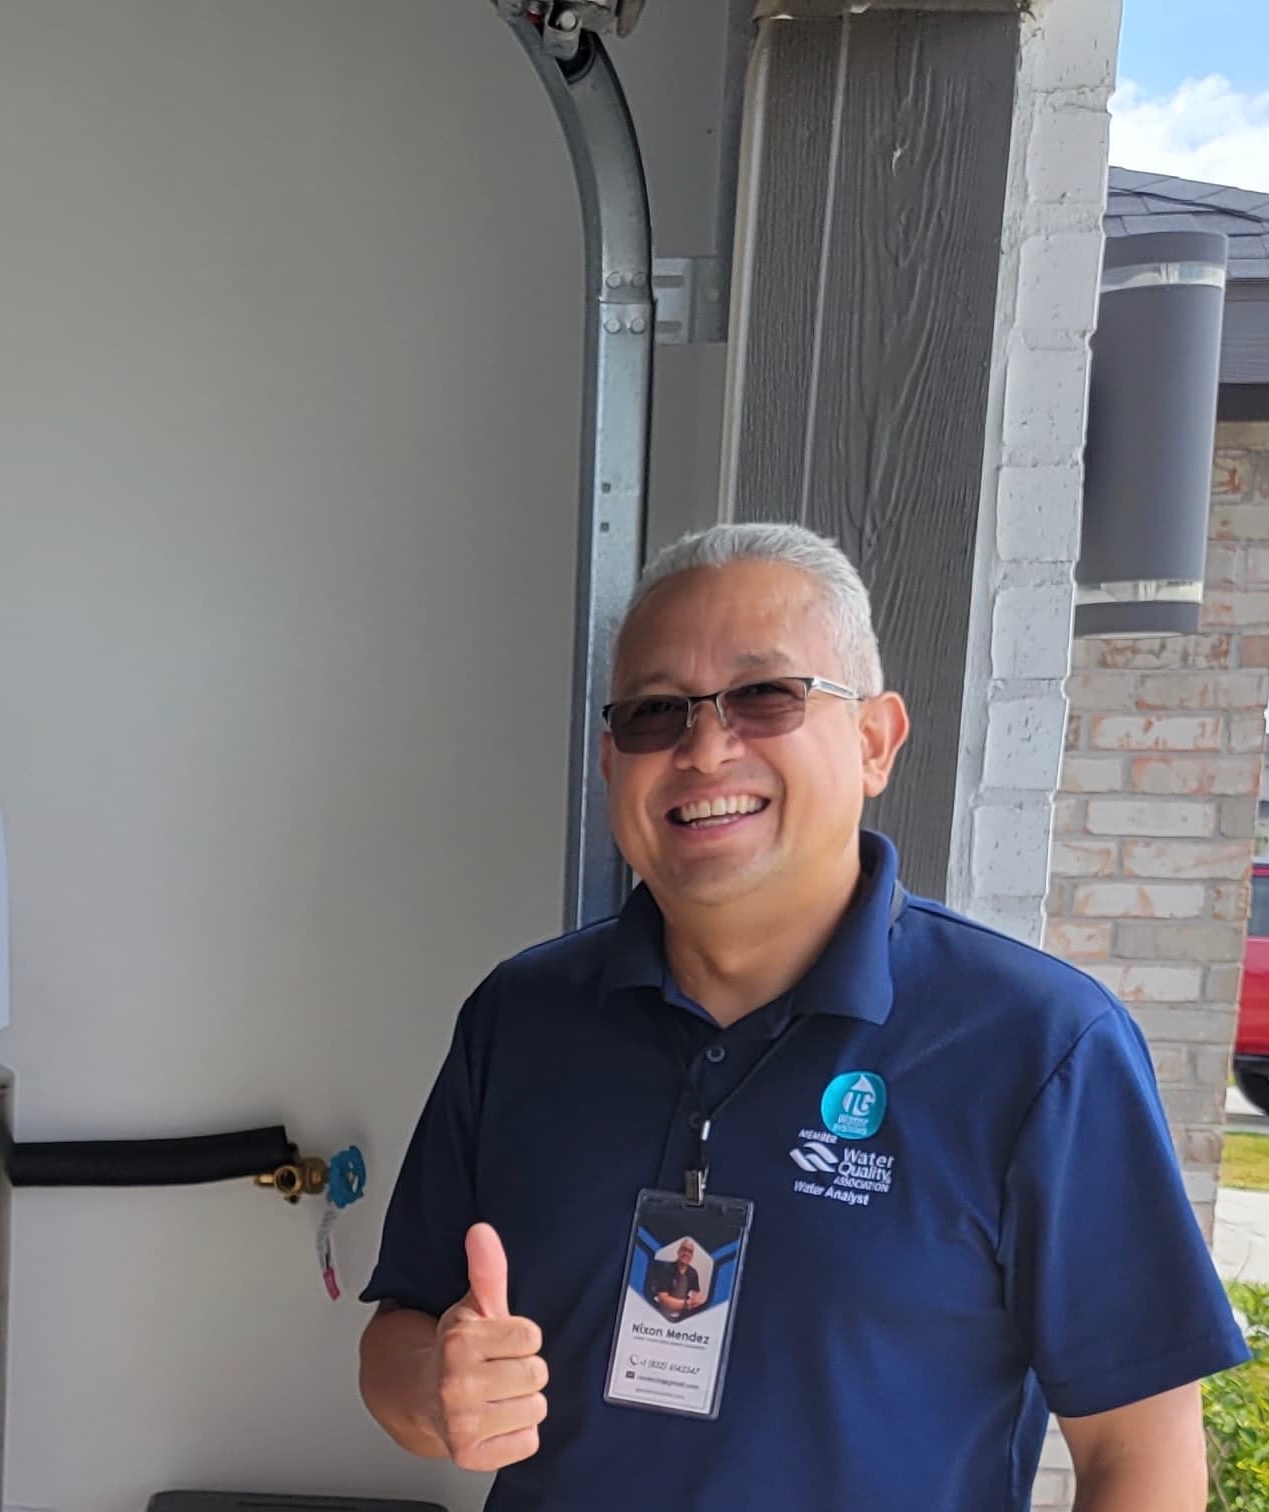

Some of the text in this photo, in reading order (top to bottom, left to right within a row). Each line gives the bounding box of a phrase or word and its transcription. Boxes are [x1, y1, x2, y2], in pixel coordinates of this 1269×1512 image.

[843, 1147, 895, 1169] Water
[833, 1175, 890, 1193] ASSOCIATION
[838, 1161, 892, 1184] Quality
[793, 1180, 870, 1206] Water Analyst
[632, 1322, 664, 1338] Nixon
[665, 1328, 711, 1345] Mendez
